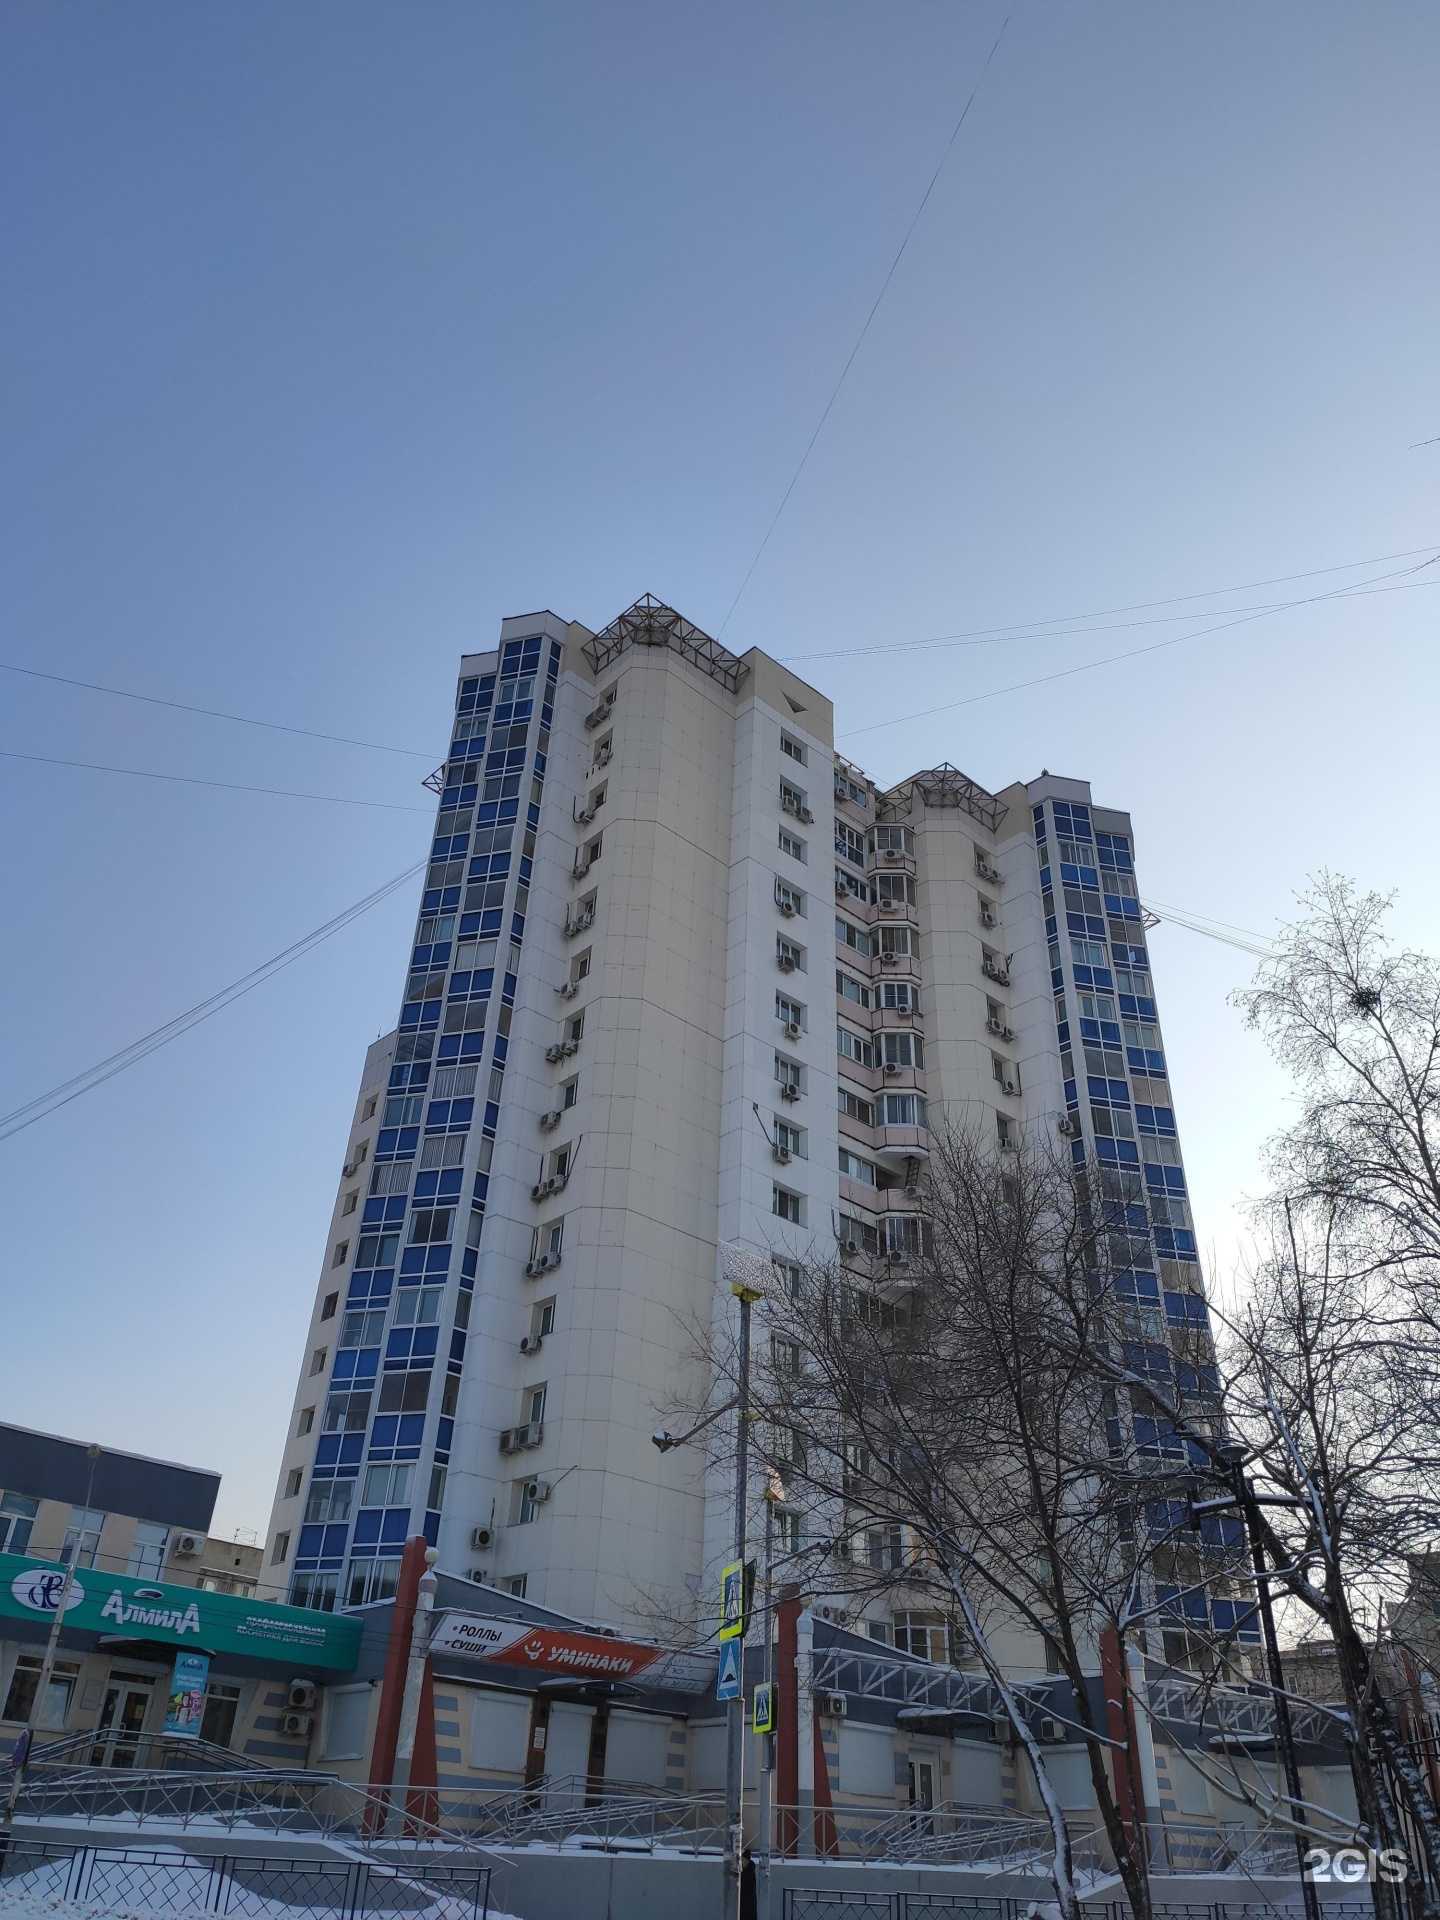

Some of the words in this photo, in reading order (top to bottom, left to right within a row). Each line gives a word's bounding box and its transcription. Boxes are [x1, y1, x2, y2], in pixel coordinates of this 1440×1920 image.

[458, 1624, 503, 1642] РОЛЛЫ
[451, 1639, 488, 1654] СУШИ
[546, 1646, 634, 1674] УМИНАКИ
